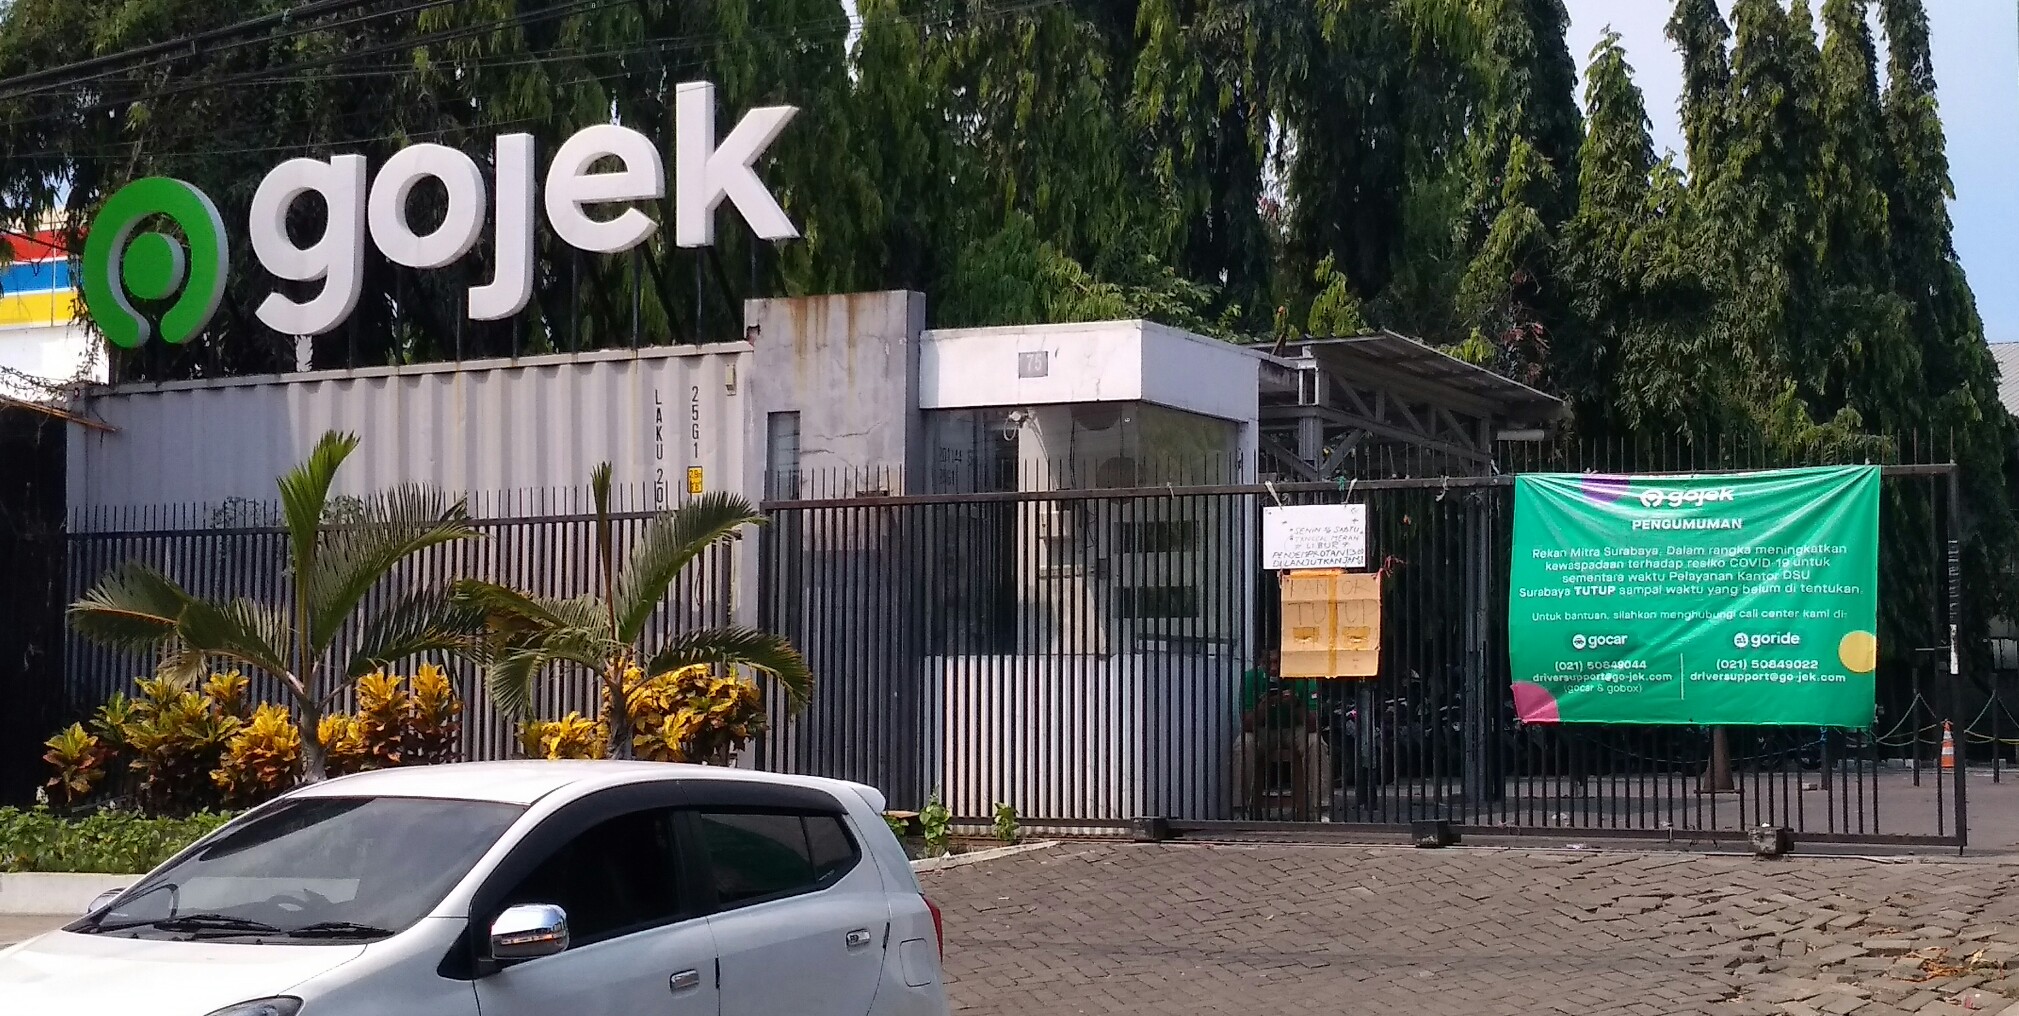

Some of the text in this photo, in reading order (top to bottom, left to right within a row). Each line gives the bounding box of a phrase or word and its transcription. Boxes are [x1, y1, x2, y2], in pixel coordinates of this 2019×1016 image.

[249, 81, 800, 335] gojek
[1027, 354, 1042, 372] 75
[655, 389, 663, 460] LAKU
[691, 386, 699, 458] 25G1
[1667, 487, 1735, 508] gojek
[1632, 518, 1743, 530] PENGUMUMAN
[1532, 549, 1567, 559] Rekan
[1570, 547, 1600, 557] Mitra
[1666, 546, 1704, 555] Dalam
[1709, 545, 1751, 557] rangka
[1755, 543, 1847, 557] meningkatkan
[1545, 561, 1624, 572] kewaspadaan
[1628, 558, 1683, 570] terhadap
[1688, 558, 1726, 568] resiko
[1793, 556, 1830, 567] untuk
[1562, 570, 1810, 583] sementara waktu Pelayanan Kantor DSU
[1519, 587, 1570, 598] Surabaya
[1574, 585, 1616, 596] TUTUP
[1619, 584, 1662, 596] sampai
[1666, 585, 1703, 595] waktu
[1707, 586, 1738, 597] yang
[1742, 584, 1781, 595] belum
[1784, 583, 1797, 593] di
[1532, 612, 1561, 621] Untuk
[1613, 610, 1657, 620] silahkan
[1660, 609, 1735, 622] menghubungi
[1739, 608, 1758, 618] call
[1761, 609, 1799, 619] center
[1803, 608, 1830, 618] kami
[1588, 633, 1629, 649] gocar
[1751, 631, 1801, 648] goride
[1555, 660, 1647, 672] (021) 50849044
[1716, 658, 1819, 670] (021) 50849022
[1533, 672, 1673, 683] driversupport@go-jek.com
[1564, 684, 1594, 694] (gocar
[1606, 684, 1643, 694] gobox)
